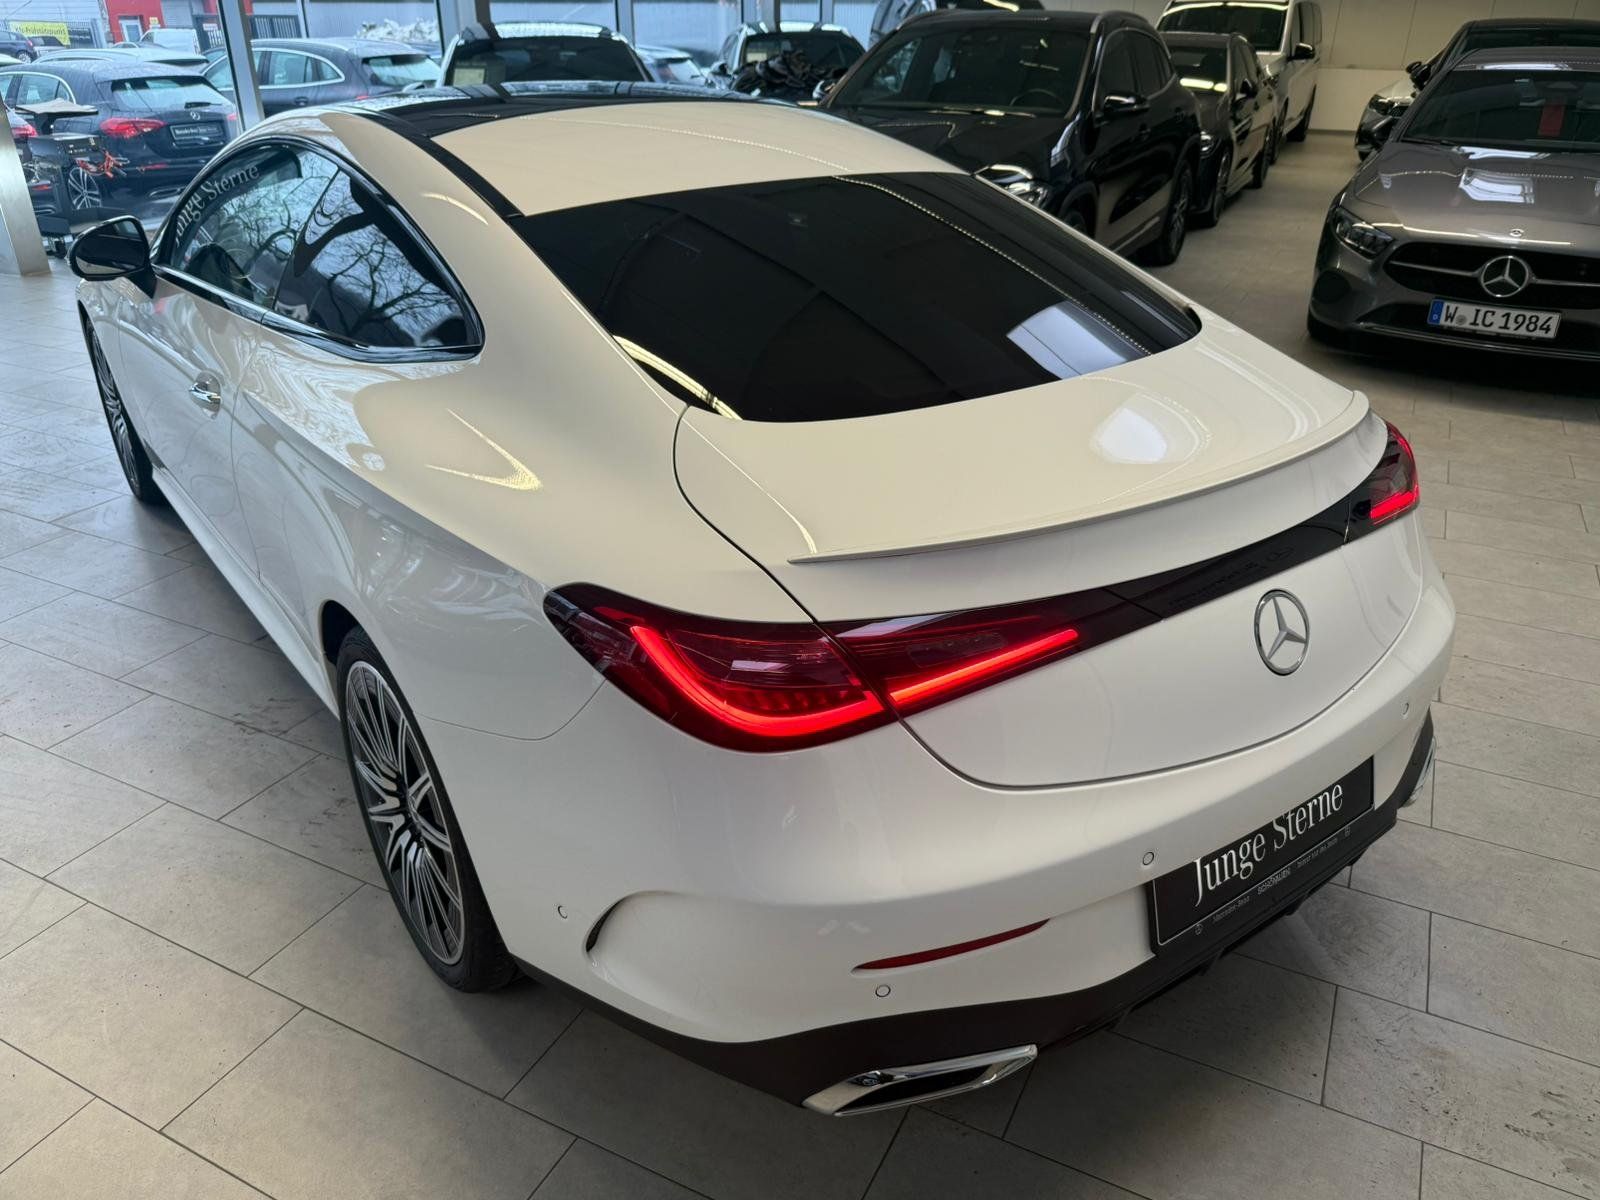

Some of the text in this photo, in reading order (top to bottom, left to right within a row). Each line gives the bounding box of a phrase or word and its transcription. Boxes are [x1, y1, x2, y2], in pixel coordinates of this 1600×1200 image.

[200, 164, 259, 200] Sterne
[1444, 304, 1459, 324] W
[1498, 312, 1553, 334] 1984
[1193, 833, 1265, 907] Junge
[1273, 783, 1344, 851] Sterne
